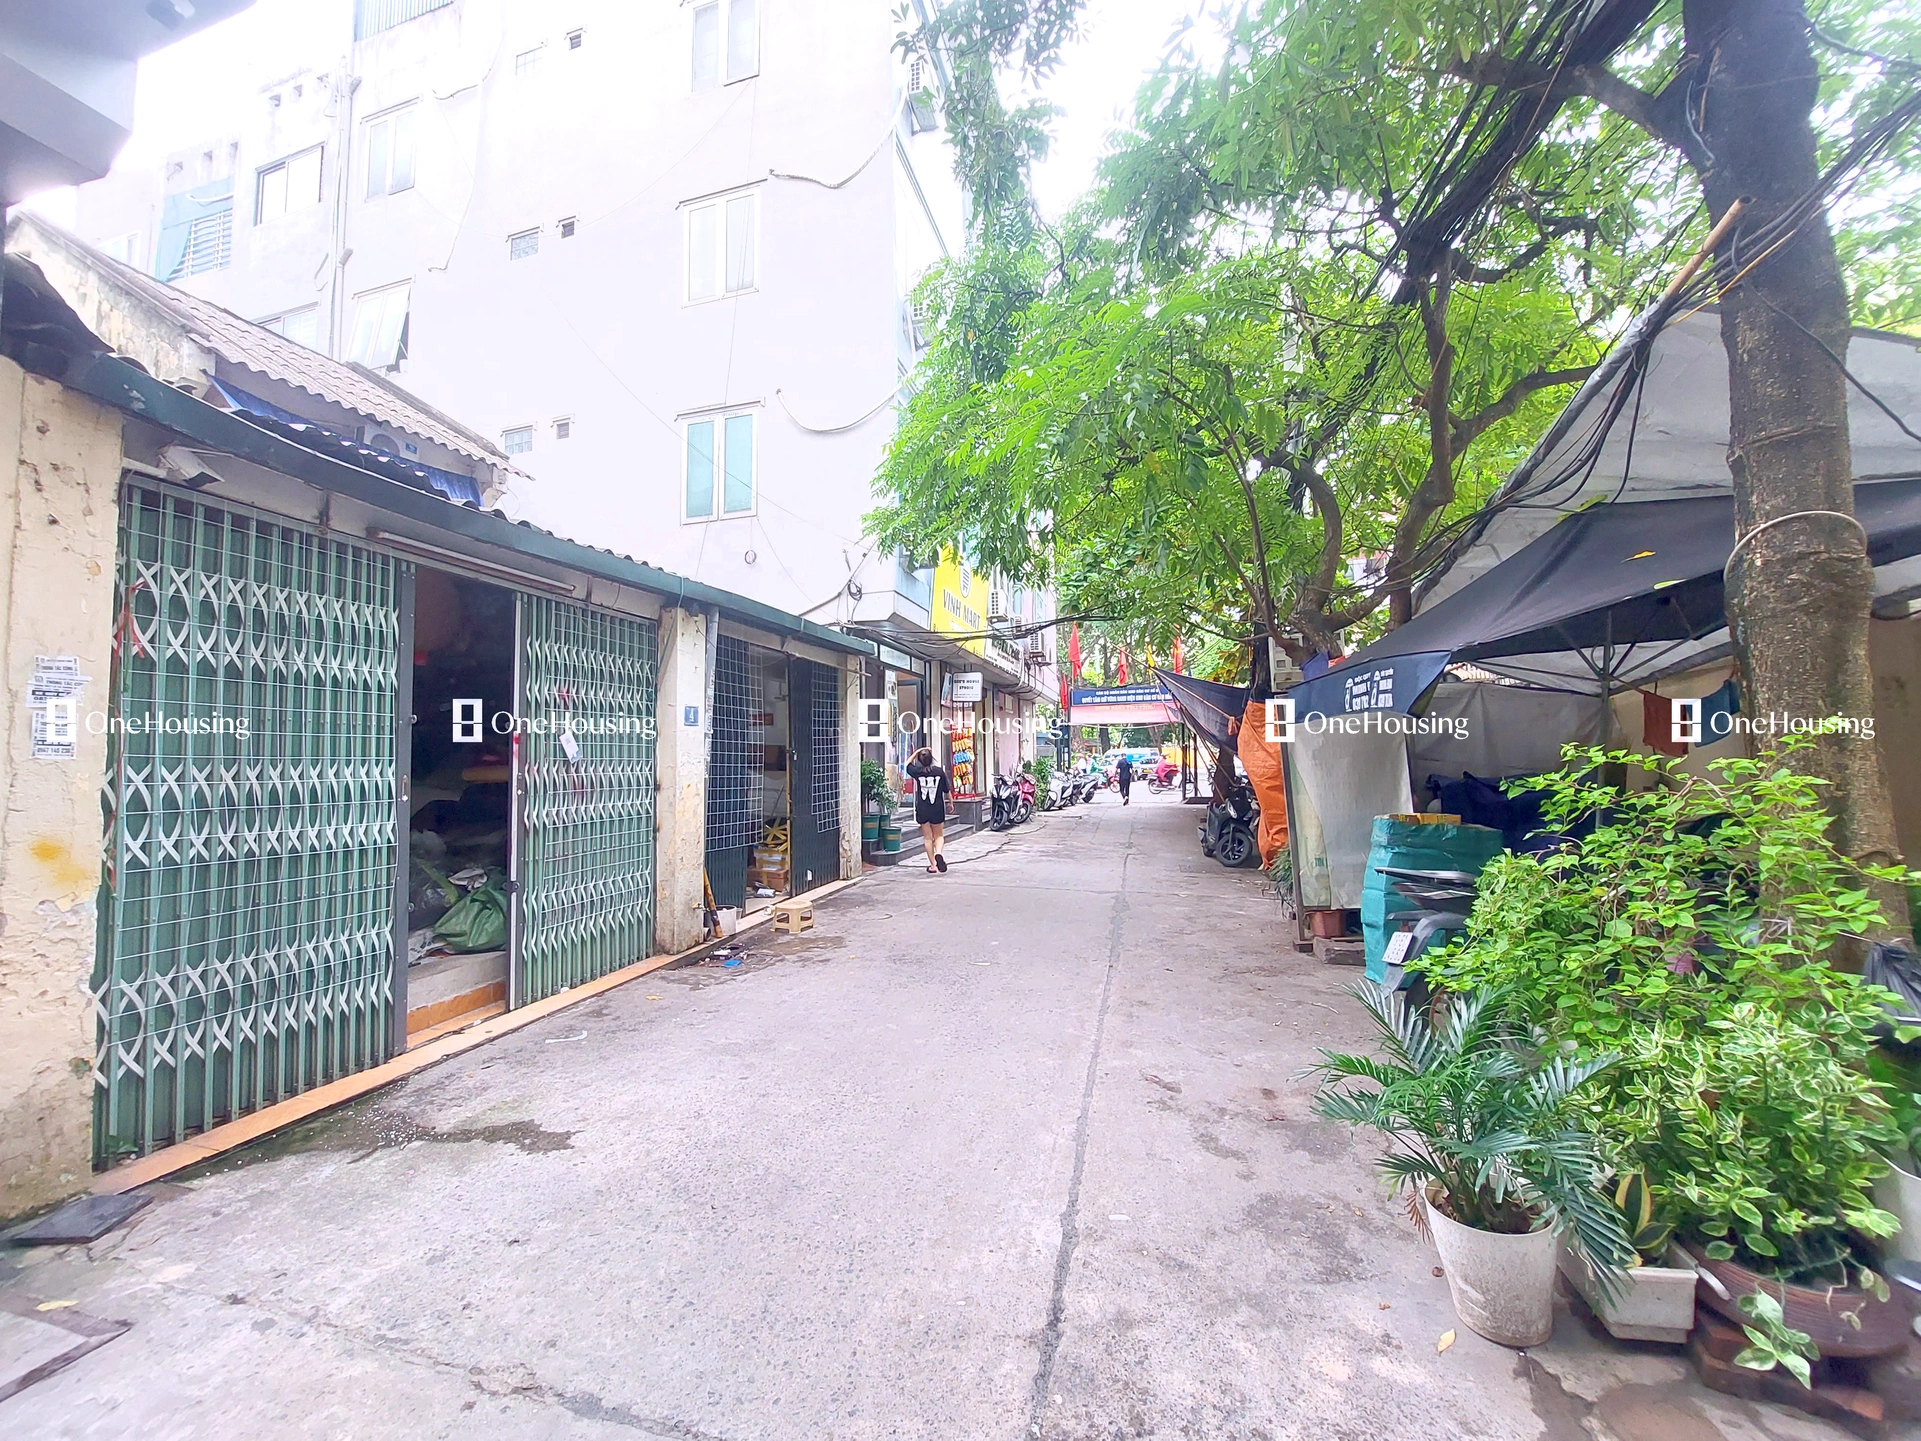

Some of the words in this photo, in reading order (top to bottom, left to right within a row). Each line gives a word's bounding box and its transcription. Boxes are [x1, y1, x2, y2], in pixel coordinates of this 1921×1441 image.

[943, 588, 962, 618] VINH
[963, 604, 980, 631] MART
[688, 705, 697, 722] 4
